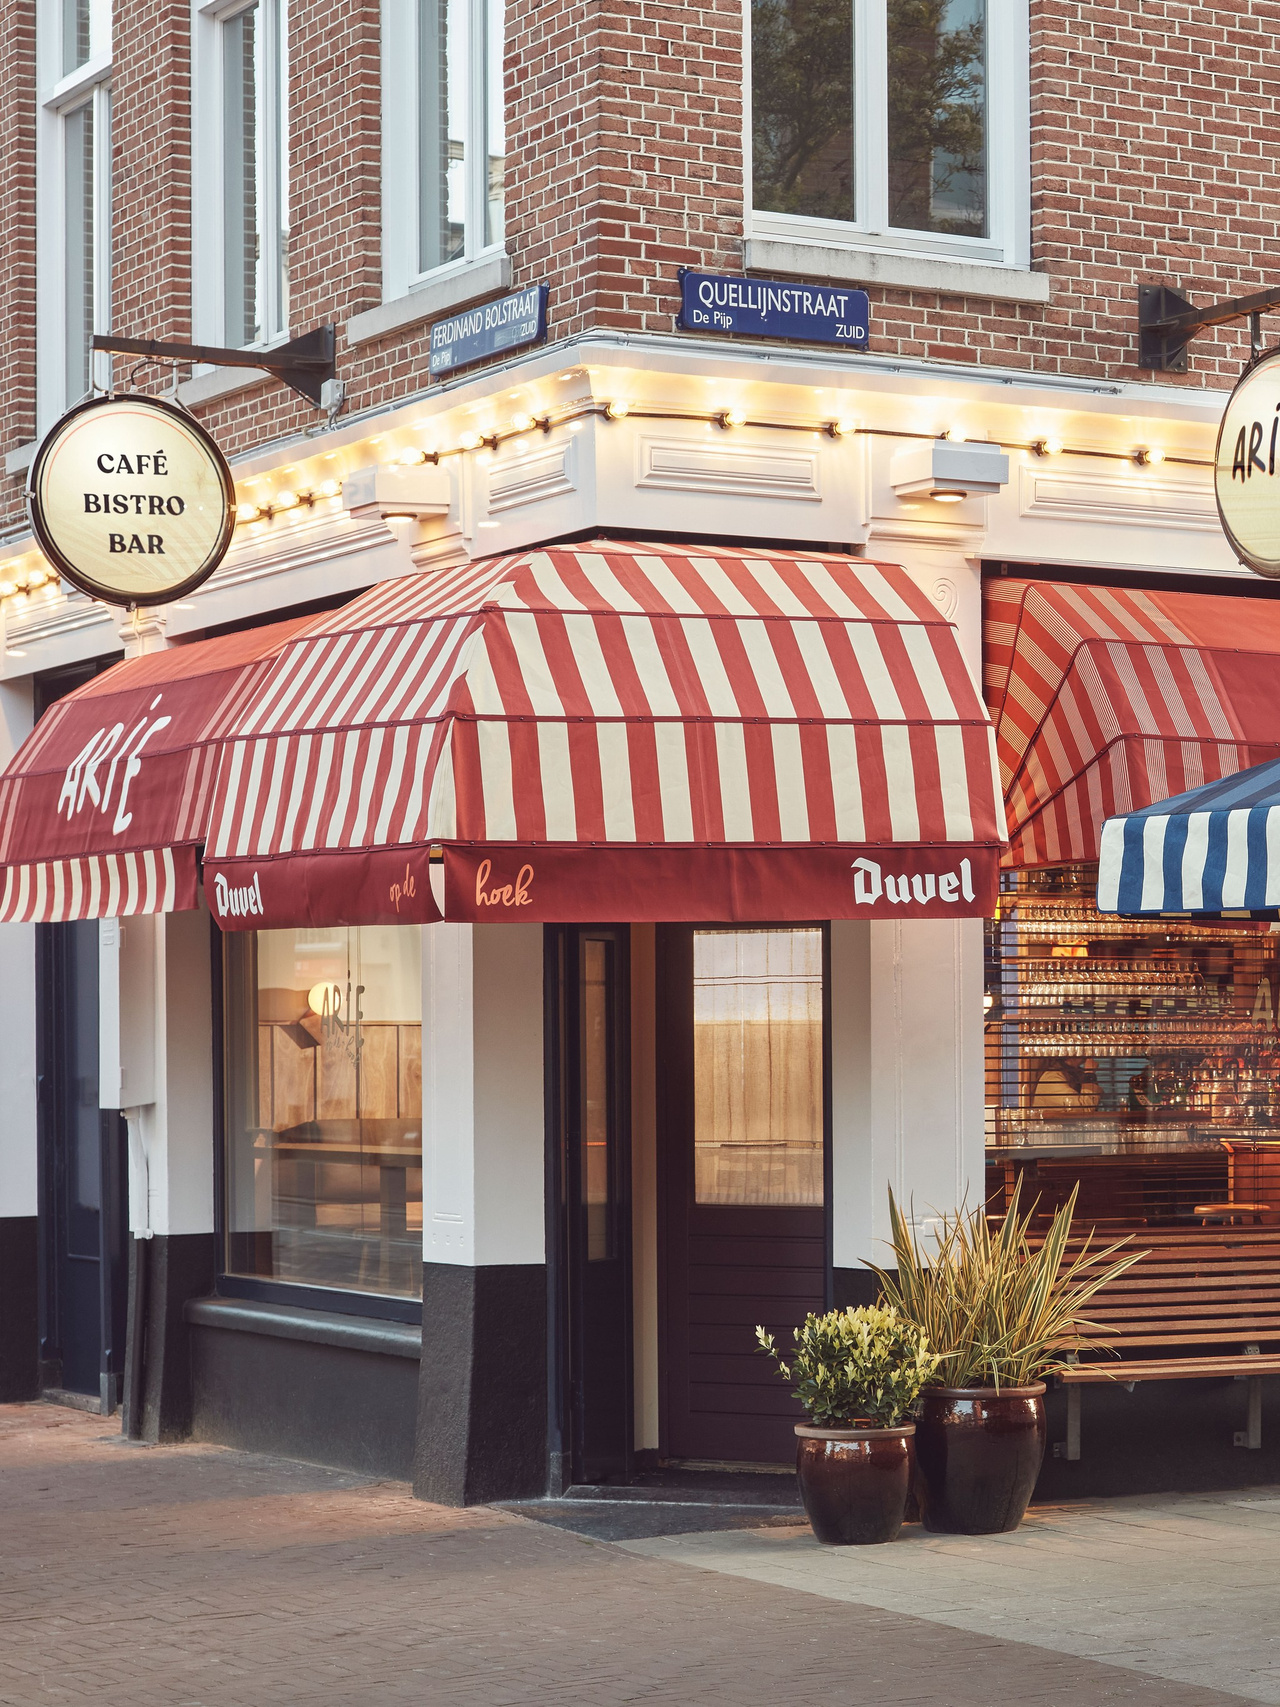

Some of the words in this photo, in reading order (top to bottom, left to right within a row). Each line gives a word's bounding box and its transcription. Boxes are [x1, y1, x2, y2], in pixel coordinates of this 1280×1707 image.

[698, 280, 849, 318] QUELLIJNSTRAAT
[433, 311, 483, 349] FERDINAND
[484, 291, 537, 331] BOLSTRAAT
[520, 320, 537, 337] ZUID
[692, 309, 710, 324] De
[713, 311, 733, 329] Pijp
[835, 324, 865, 340] ZUID
[96, 449, 169, 476] CAFÉ
[83, 493, 185, 516] BISTRO
[108, 533, 166, 555] BAR
[213, 871, 264, 917] Duvel
[389, 883, 401, 913] op
[403, 863, 416, 898] de
[475, 859, 535, 907] hoek
[850, 857, 976, 905] Duvel
